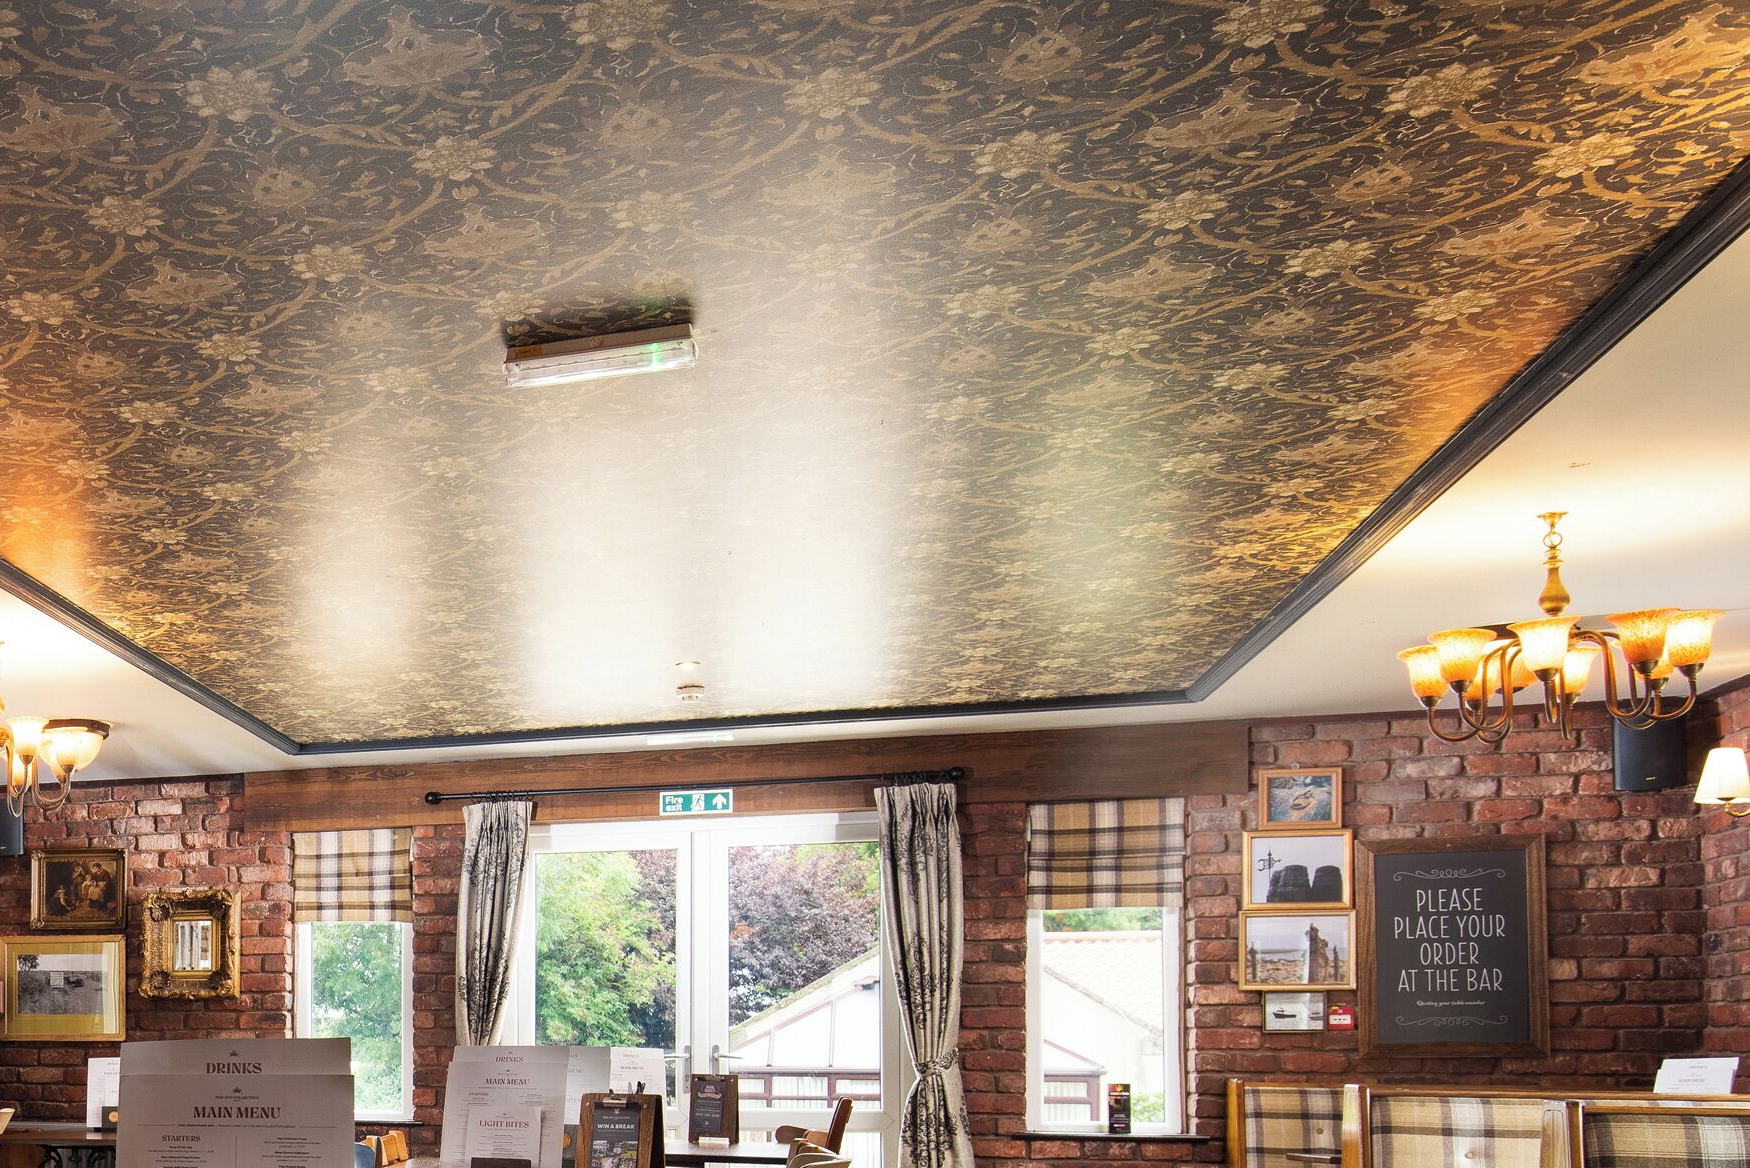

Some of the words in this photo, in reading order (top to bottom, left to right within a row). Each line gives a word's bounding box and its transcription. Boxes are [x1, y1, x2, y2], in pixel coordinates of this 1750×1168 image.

[665, 795, 684, 804] Fire
[665, 803, 683, 812] exit
[1416, 888, 1484, 912] PLEASE
[1394, 915, 1451, 940] PLACE
[1456, 914, 1507, 938] YOUR
[1420, 942, 1480, 966] ORDER
[1397, 969, 1419, 992] AT
[1424, 969, 1461, 992] THE
[1467, 968, 1504, 992] BAR
[205, 1062, 263, 1074] DRINKS
[507, 1078, 530, 1086] MENU
[193, 1106, 233, 1119] MAIN
[236, 1106, 281, 1119] MENU
[479, 1120, 504, 1128] LIGHT
[505, 1120, 530, 1129] BITES
